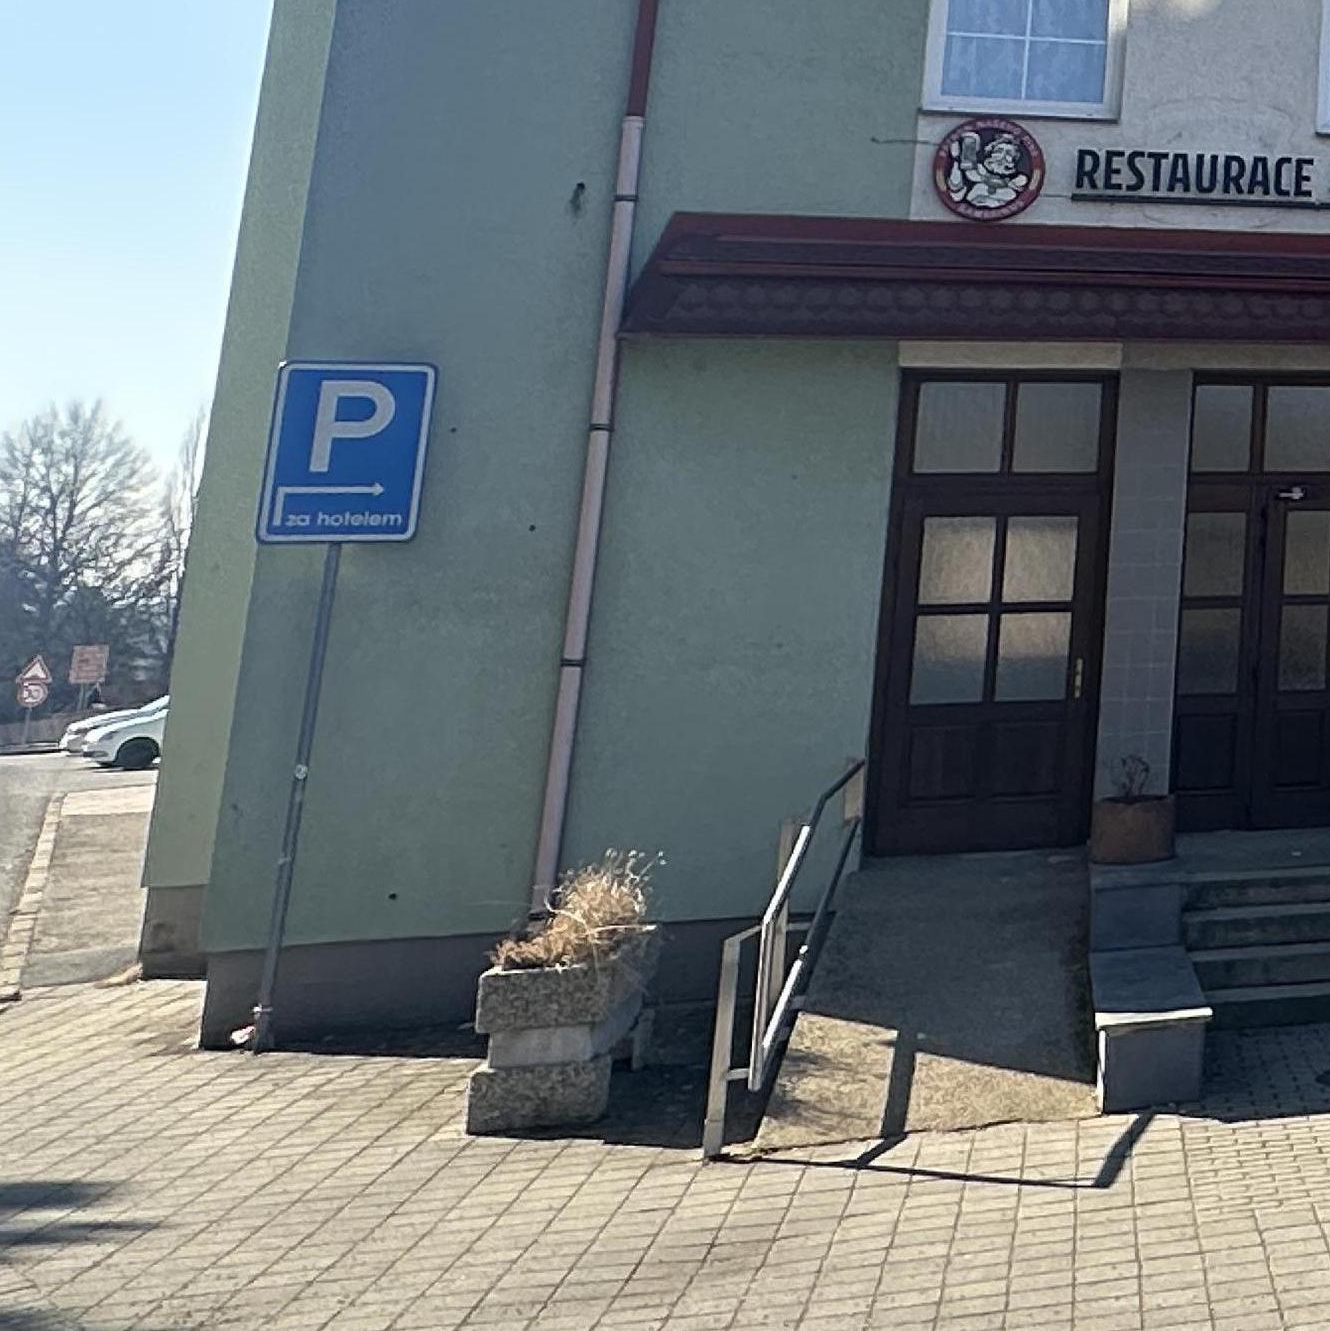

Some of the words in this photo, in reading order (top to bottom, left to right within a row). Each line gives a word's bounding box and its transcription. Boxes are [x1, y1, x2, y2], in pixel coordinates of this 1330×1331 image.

[1075, 149, 1314, 197] RESTAURACE
[309, 380, 396, 472] P
[286, 514, 310, 526] za
[317, 511, 402, 526] hotelem
